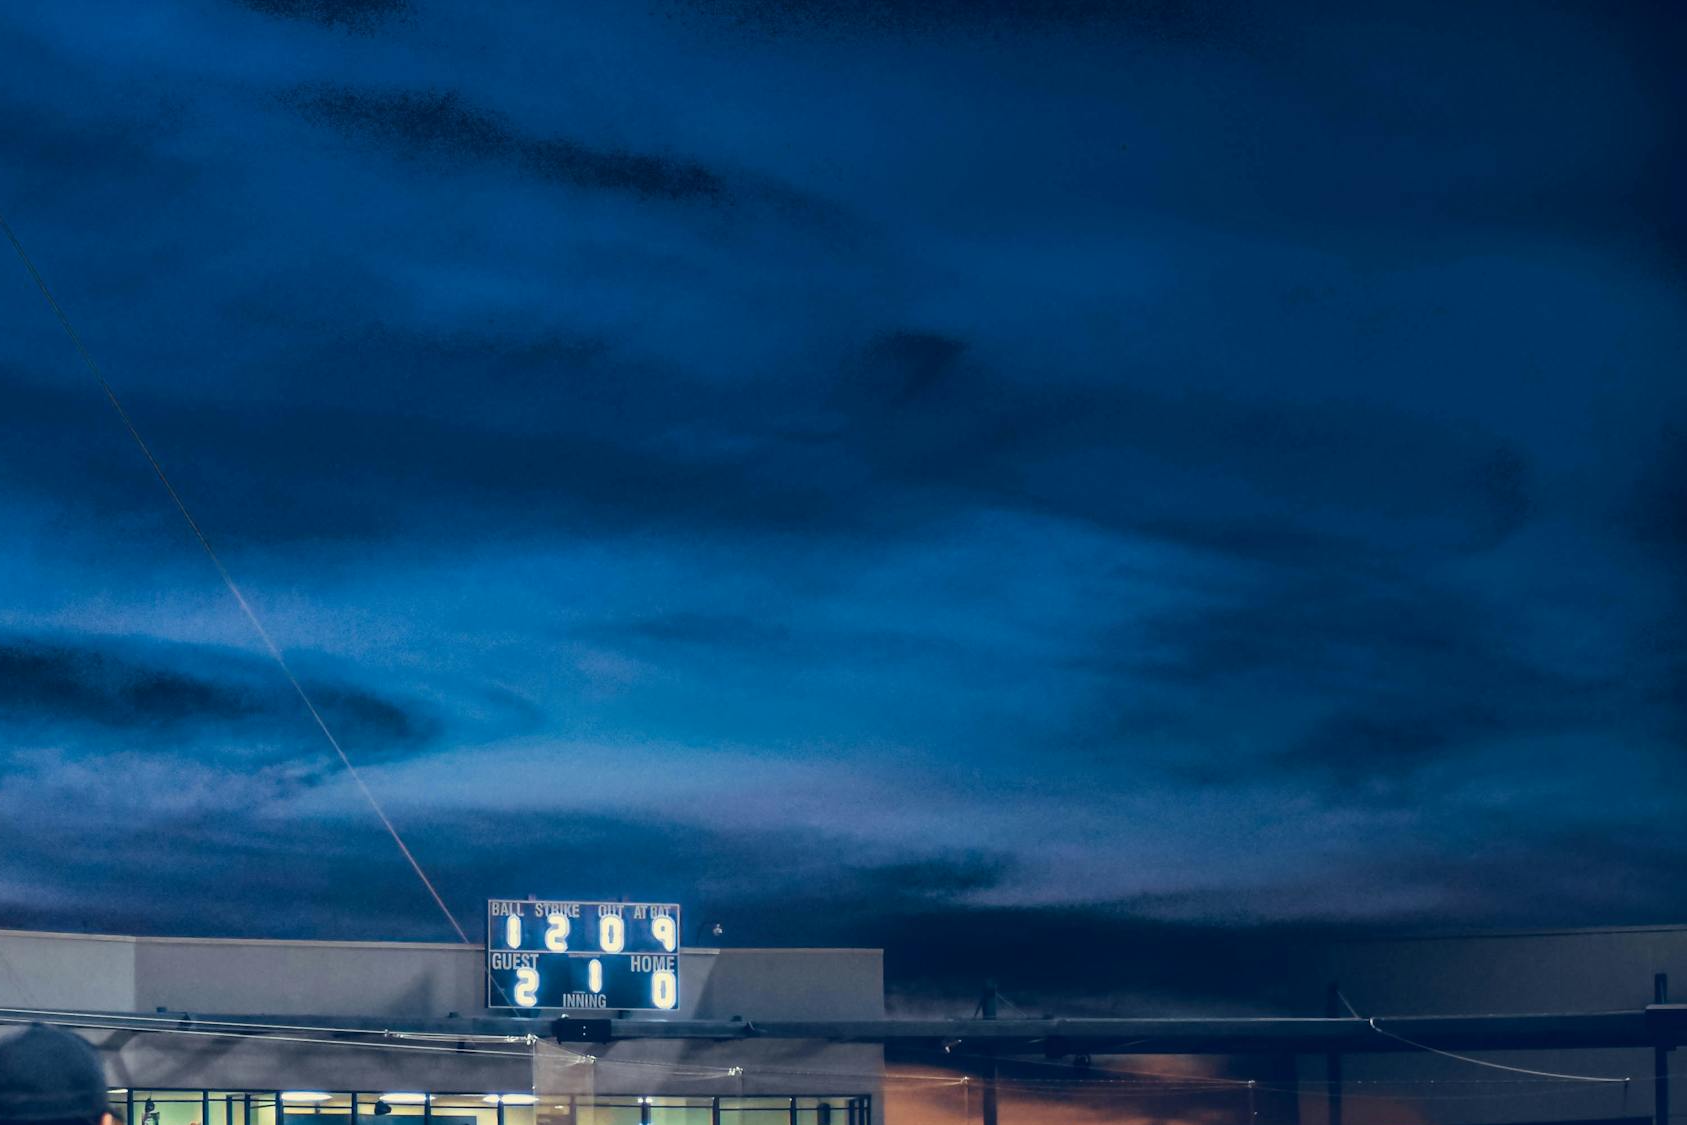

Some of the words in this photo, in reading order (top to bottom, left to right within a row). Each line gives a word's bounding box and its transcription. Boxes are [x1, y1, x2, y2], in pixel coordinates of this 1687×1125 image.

[491, 902, 525, 917] BALL
[535, 903, 580, 919] STRIKE
[598, 904, 625, 919] OUT
[633, 905, 648, 920] AT
[650, 905, 672, 919] BAT
[506, 914, 522, 950] 1
[545, 914, 570, 953] 2
[599, 914, 625, 953] 0
[652, 916, 677, 952] 9
[492, 953, 539, 970] GUEST
[630, 955, 675, 973] HOME
[514, 967, 540, 1008] 2
[588, 957, 603, 994] 1
[651, 971, 677, 1010] 0
[562, 993, 607, 1009] INNING
